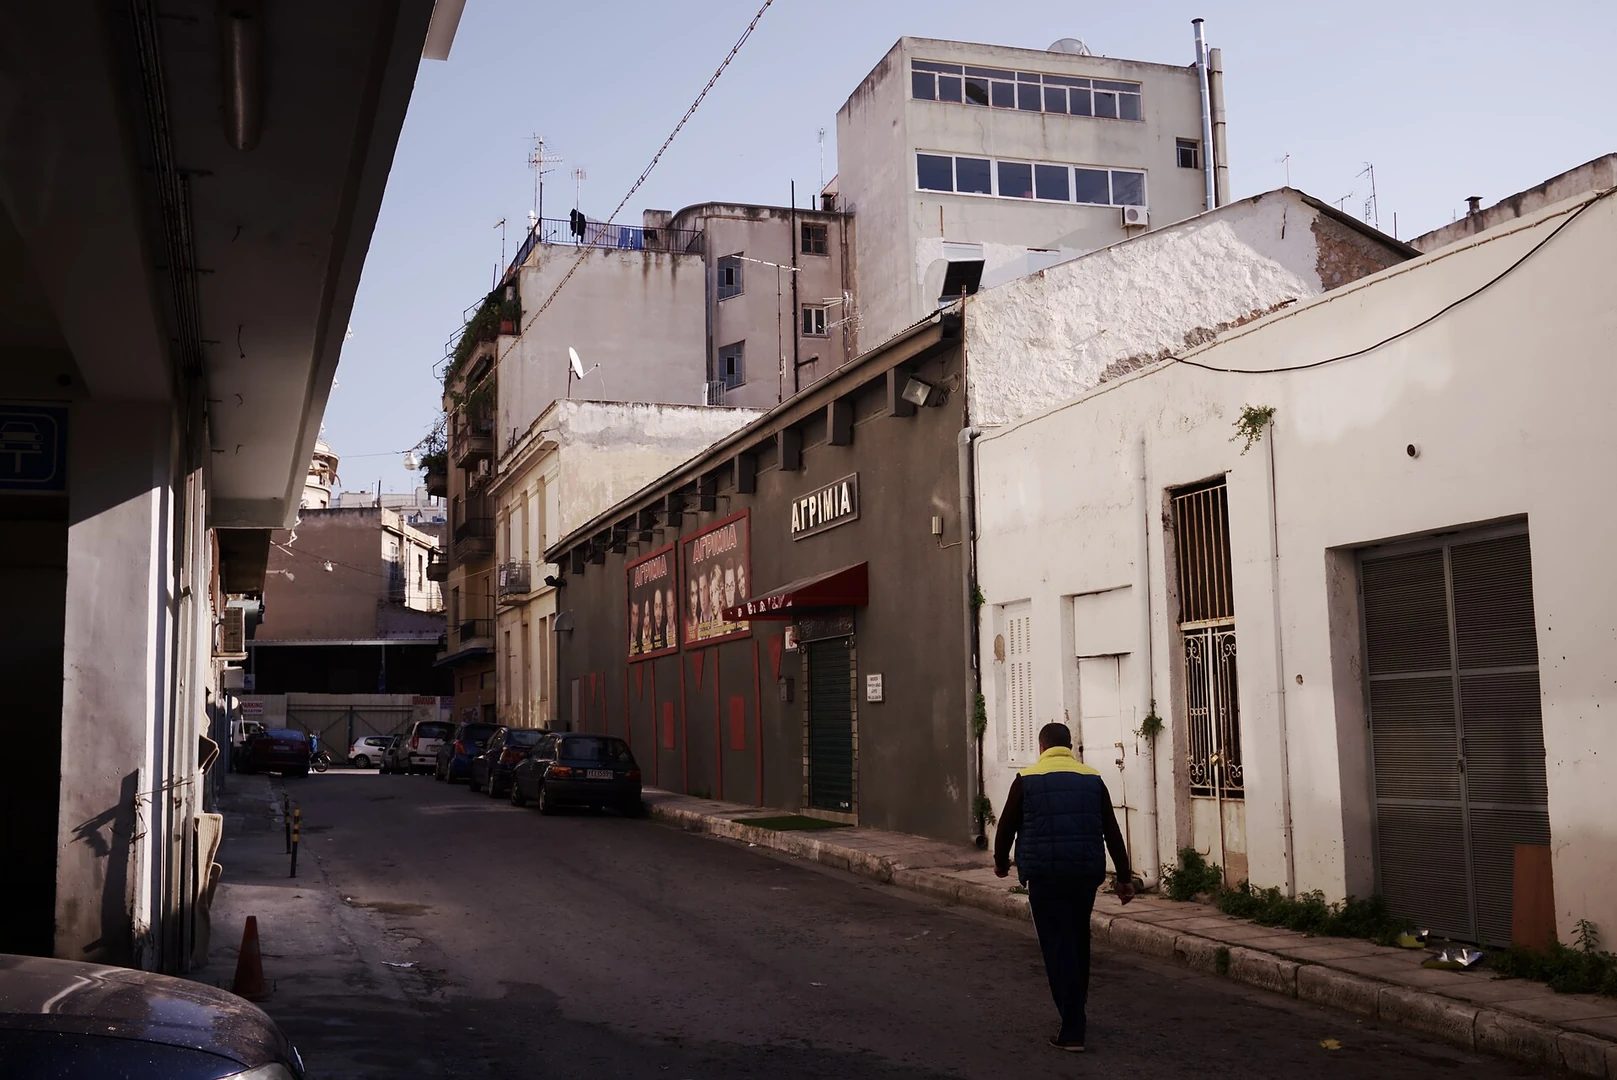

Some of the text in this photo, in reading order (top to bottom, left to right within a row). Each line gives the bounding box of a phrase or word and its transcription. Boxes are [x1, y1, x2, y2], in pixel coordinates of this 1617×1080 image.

[791, 482, 852, 534] ΑΓΡΙΜΙΑ
[693, 523, 737, 565] ΑΓΡΙΜΙΑ
[634, 554, 667, 588] ΑΓΡΙΜΙΑ
